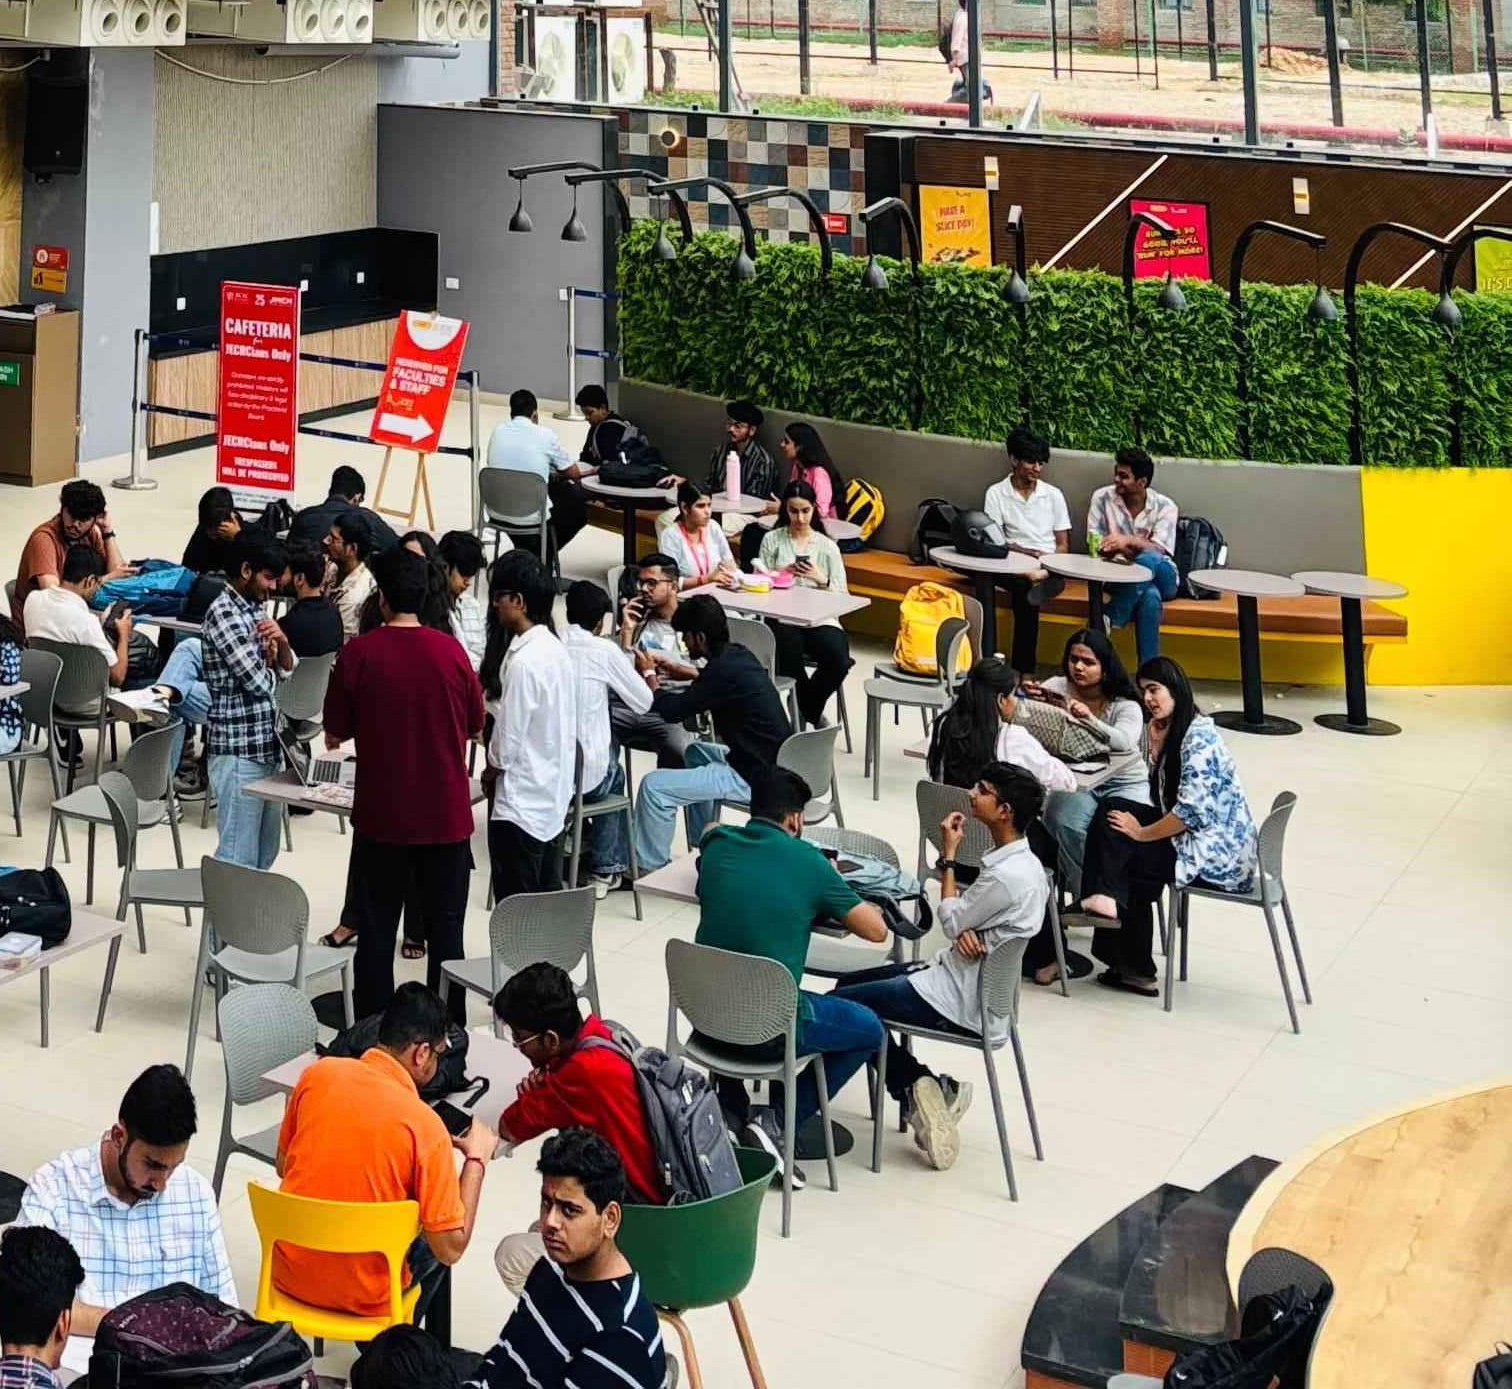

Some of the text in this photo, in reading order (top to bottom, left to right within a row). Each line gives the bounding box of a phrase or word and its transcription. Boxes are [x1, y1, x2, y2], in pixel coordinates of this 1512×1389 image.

[960, 205, 966, 214] A
[935, 220, 955, 231] SLICE
[1170, 236, 1199, 246] YOU'LL
[1159, 248, 1176, 257] FOR
[225, 317, 292, 340] CAFETERIA
[271, 348, 292, 363] Only
[392, 366, 446, 388] FACULTIES
[398, 380, 431, 396] STAFF
[269, 439, 290, 456] Only
